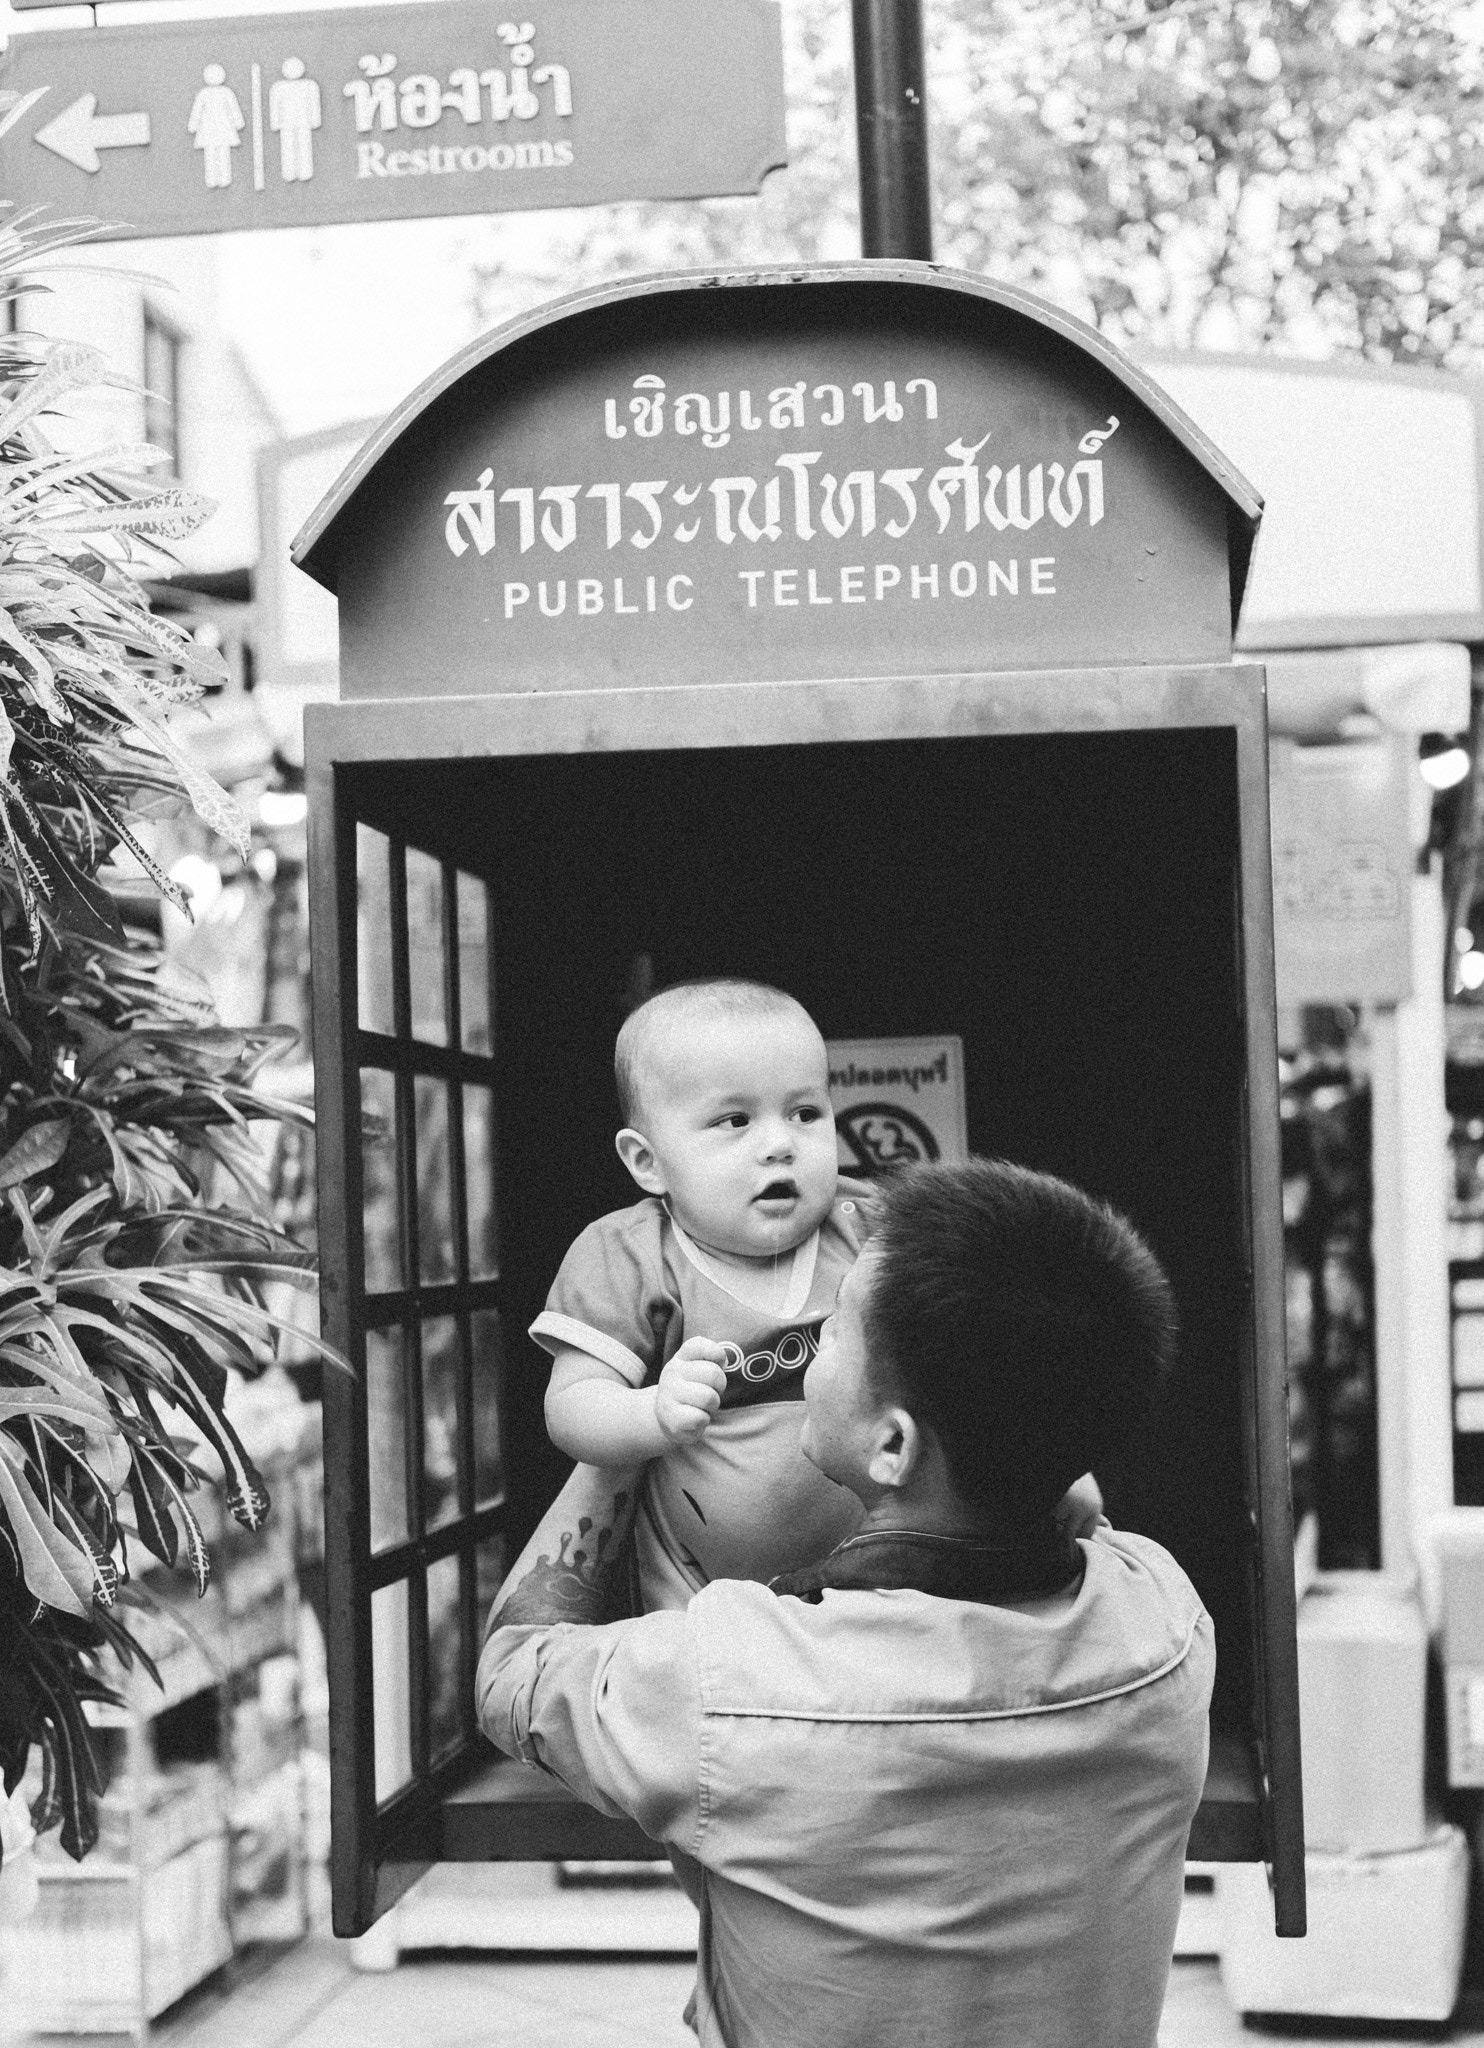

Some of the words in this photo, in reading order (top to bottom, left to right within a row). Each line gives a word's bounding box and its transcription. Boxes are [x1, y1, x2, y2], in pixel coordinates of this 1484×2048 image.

[342, 21, 573, 132] ห้องน้ำ
[356, 140, 574, 179] Restrooms
[604, 373, 940, 449] เชิญเสวนา
[503, 574, 695, 619] PUBLIC
[737, 557, 1057, 610] TELEPHONE
